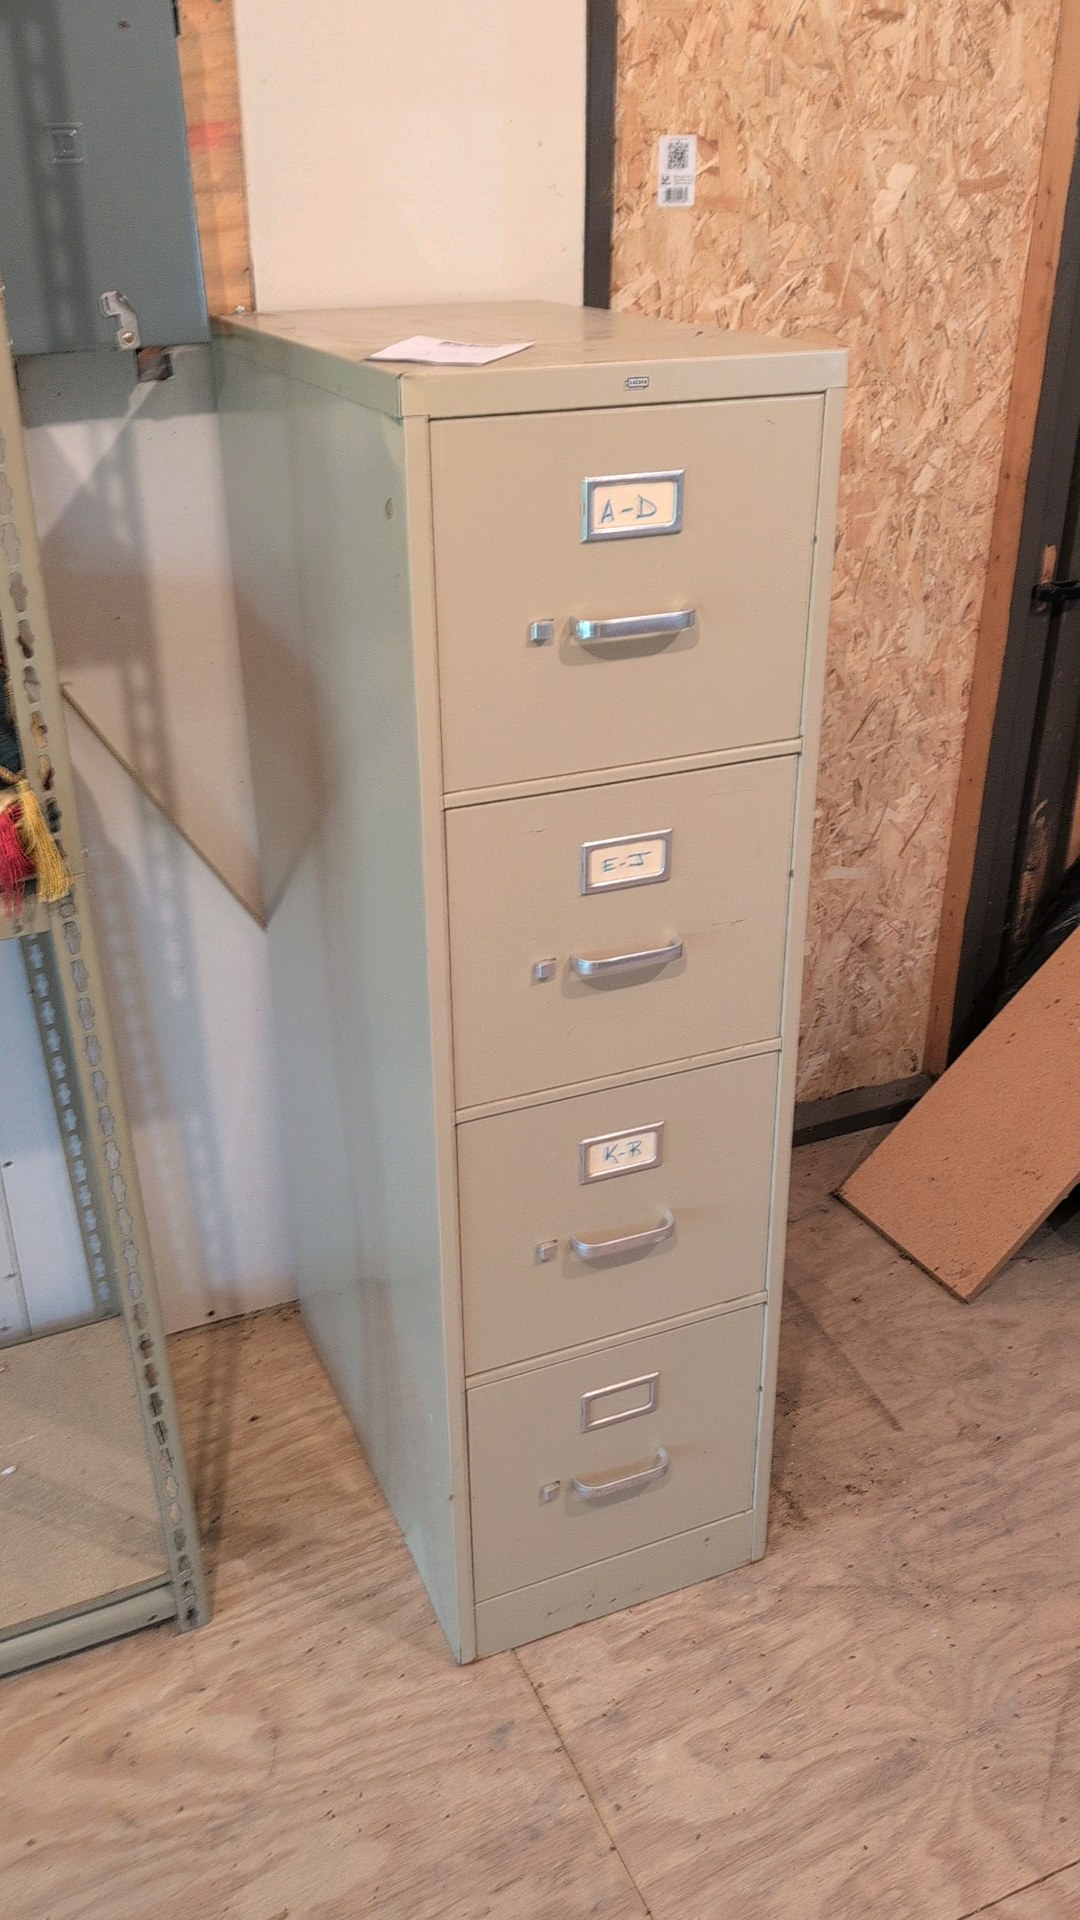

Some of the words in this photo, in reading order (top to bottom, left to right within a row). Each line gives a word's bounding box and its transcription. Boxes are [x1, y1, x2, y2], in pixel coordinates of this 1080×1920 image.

[601, 494, 657, 524] A-D
[603, 851, 652, 873] E-J
[605, 1140, 642, 1163] K-R
